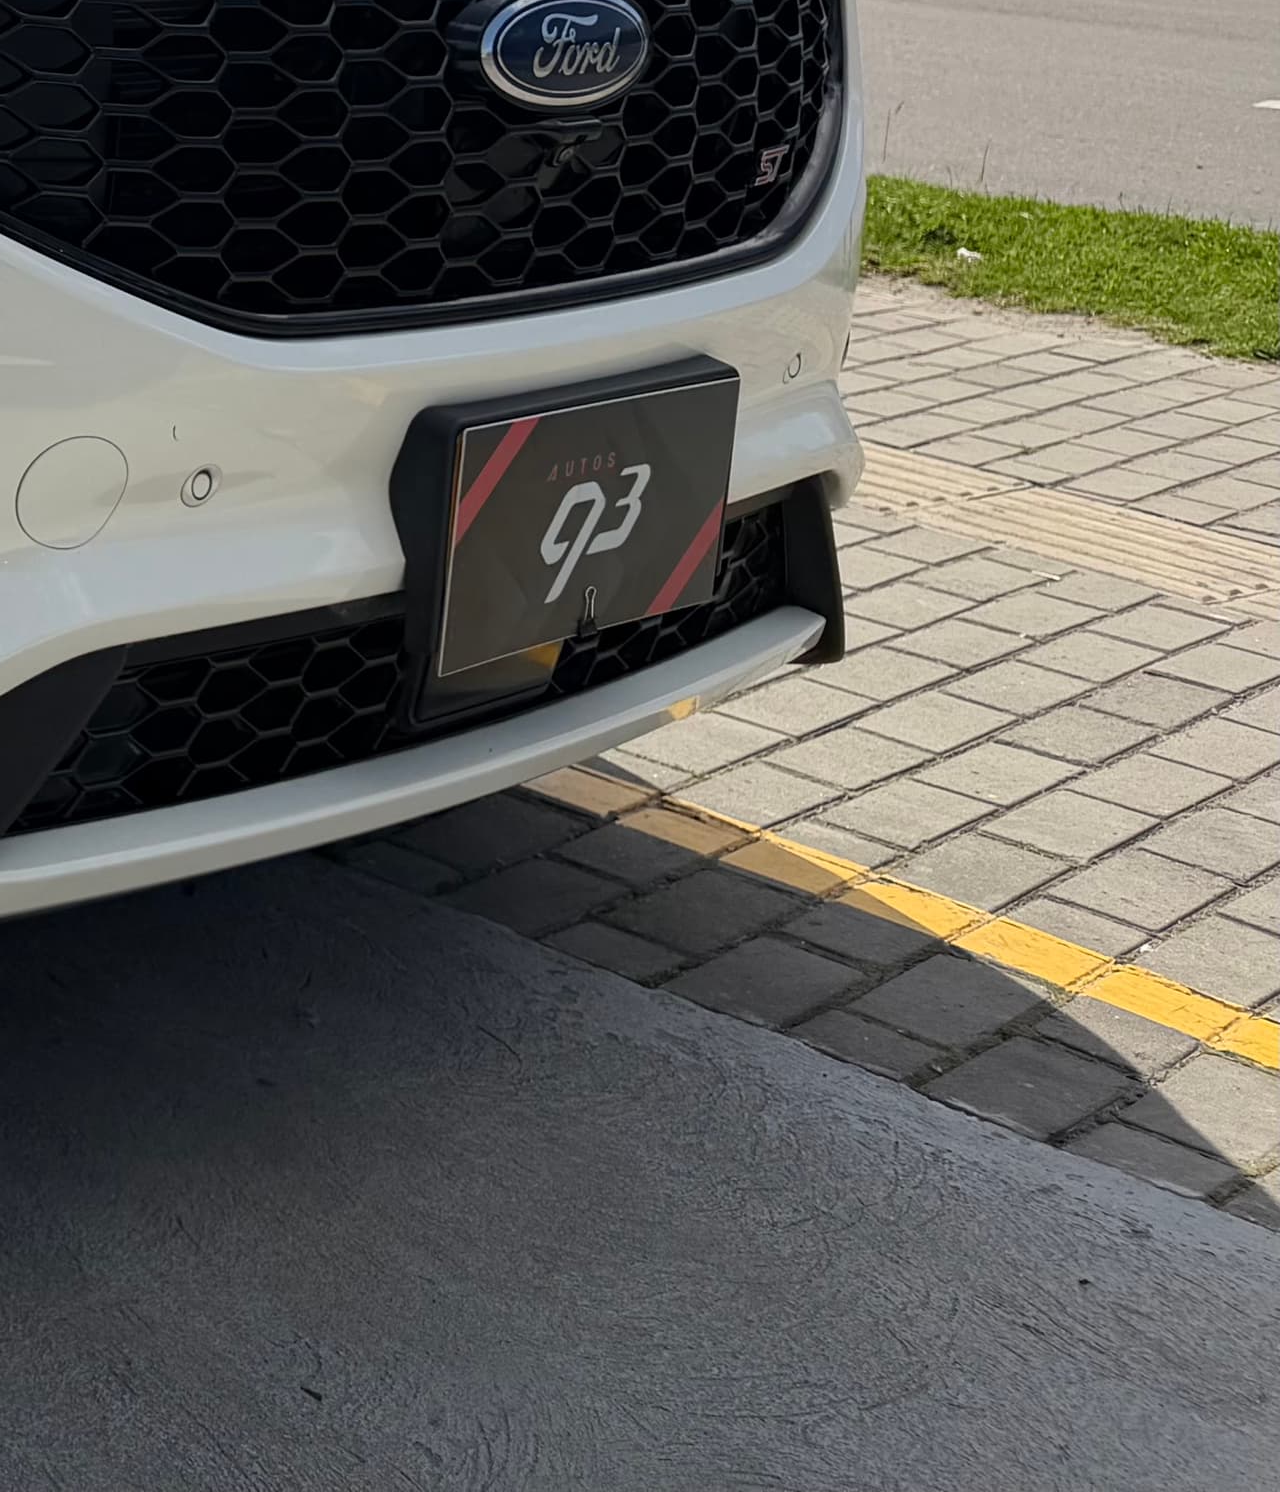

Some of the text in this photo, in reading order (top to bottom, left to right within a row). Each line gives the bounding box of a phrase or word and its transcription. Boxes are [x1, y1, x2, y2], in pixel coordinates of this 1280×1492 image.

[533, 13, 620, 77] Ford
[754, 144, 790, 186] ST
[547, 451, 616, 481] AUTOS
[540, 463, 651, 604] 93
